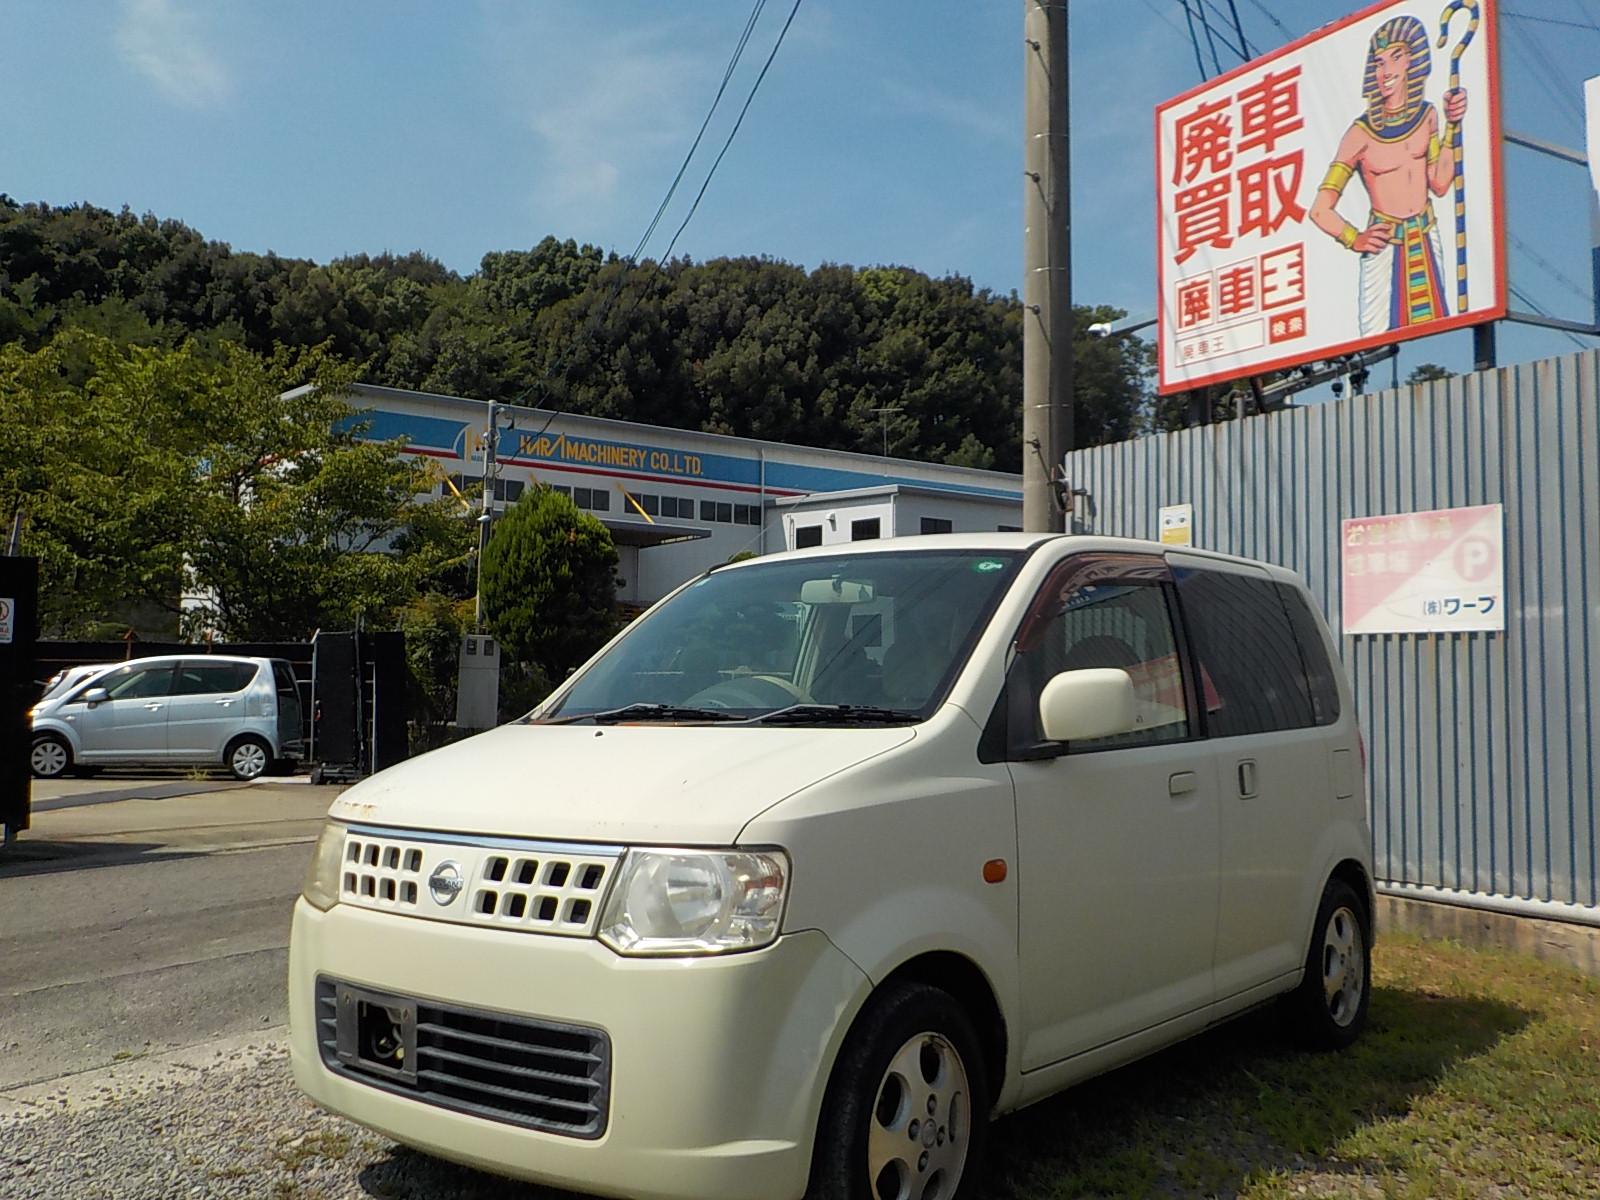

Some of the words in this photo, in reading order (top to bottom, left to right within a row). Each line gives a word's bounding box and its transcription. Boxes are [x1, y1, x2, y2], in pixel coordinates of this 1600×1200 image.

[1172, 65, 1304, 187] 廃車
[1174, 149, 1306, 266] 買取
[1177, 242, 1305, 330] 廃車王
[566, 441, 648, 469] MACHINERY
